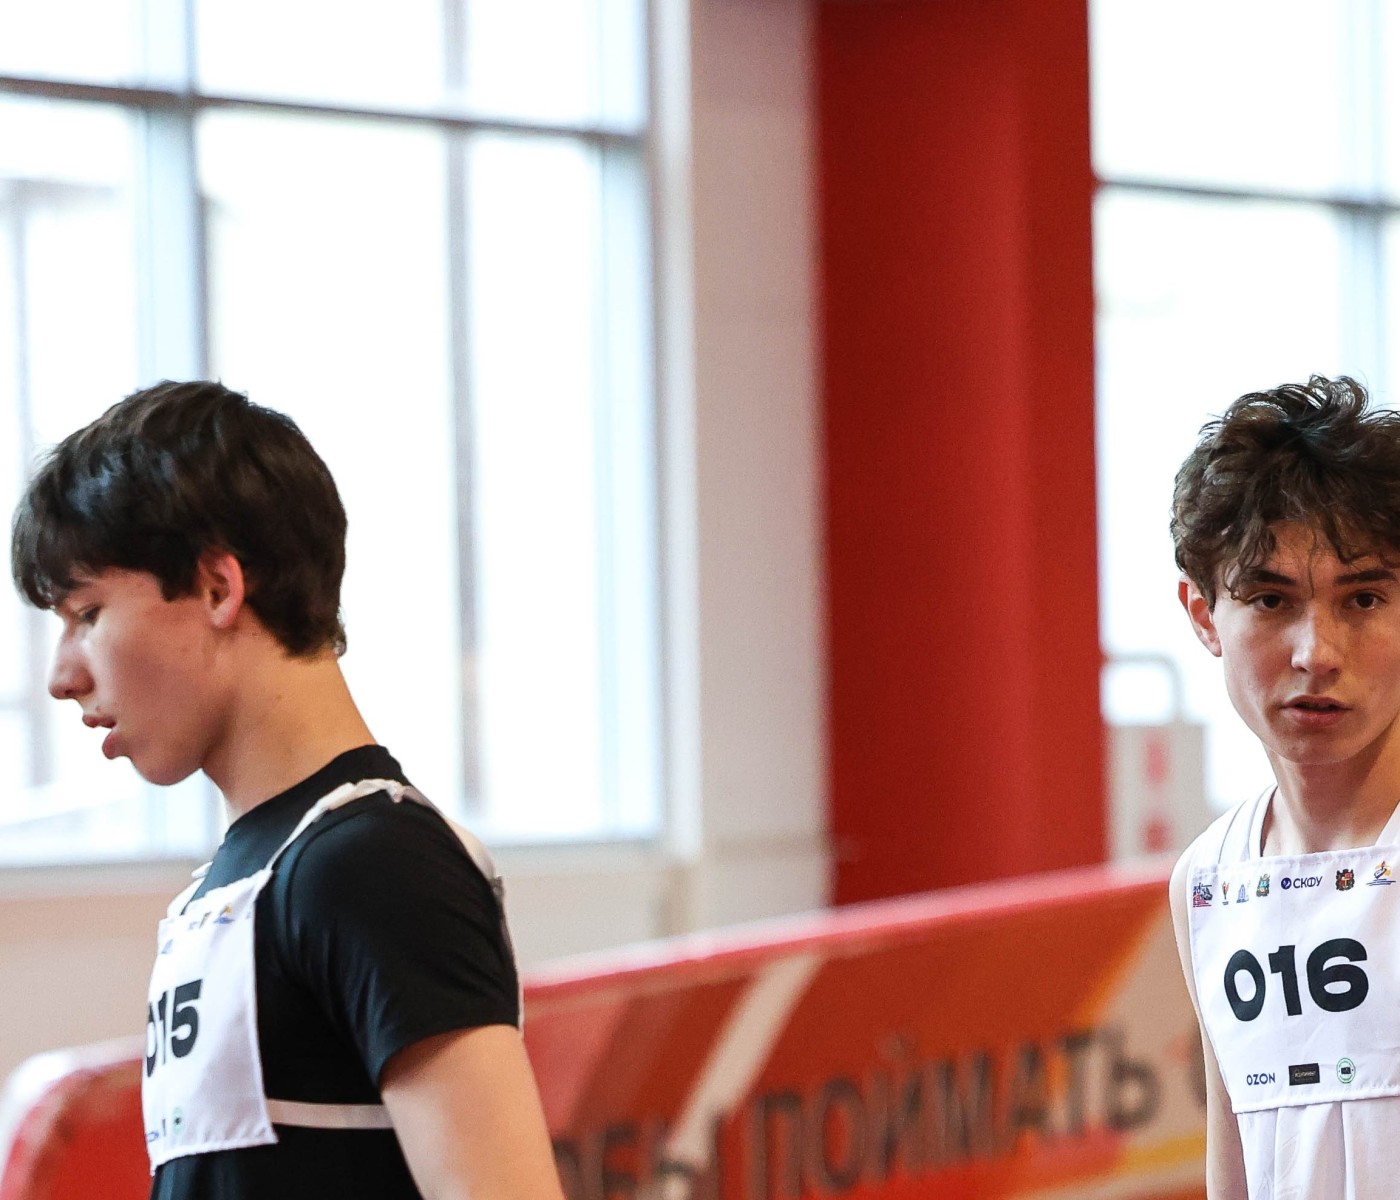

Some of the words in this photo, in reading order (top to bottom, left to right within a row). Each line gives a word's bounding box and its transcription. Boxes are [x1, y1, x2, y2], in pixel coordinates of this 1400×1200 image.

[1293, 876, 1323, 889] СКФУ
[1223, 937, 1369, 1022] 016
[146, 978, 204, 1078] 015
[1246, 1072, 1276, 1086] OZON
